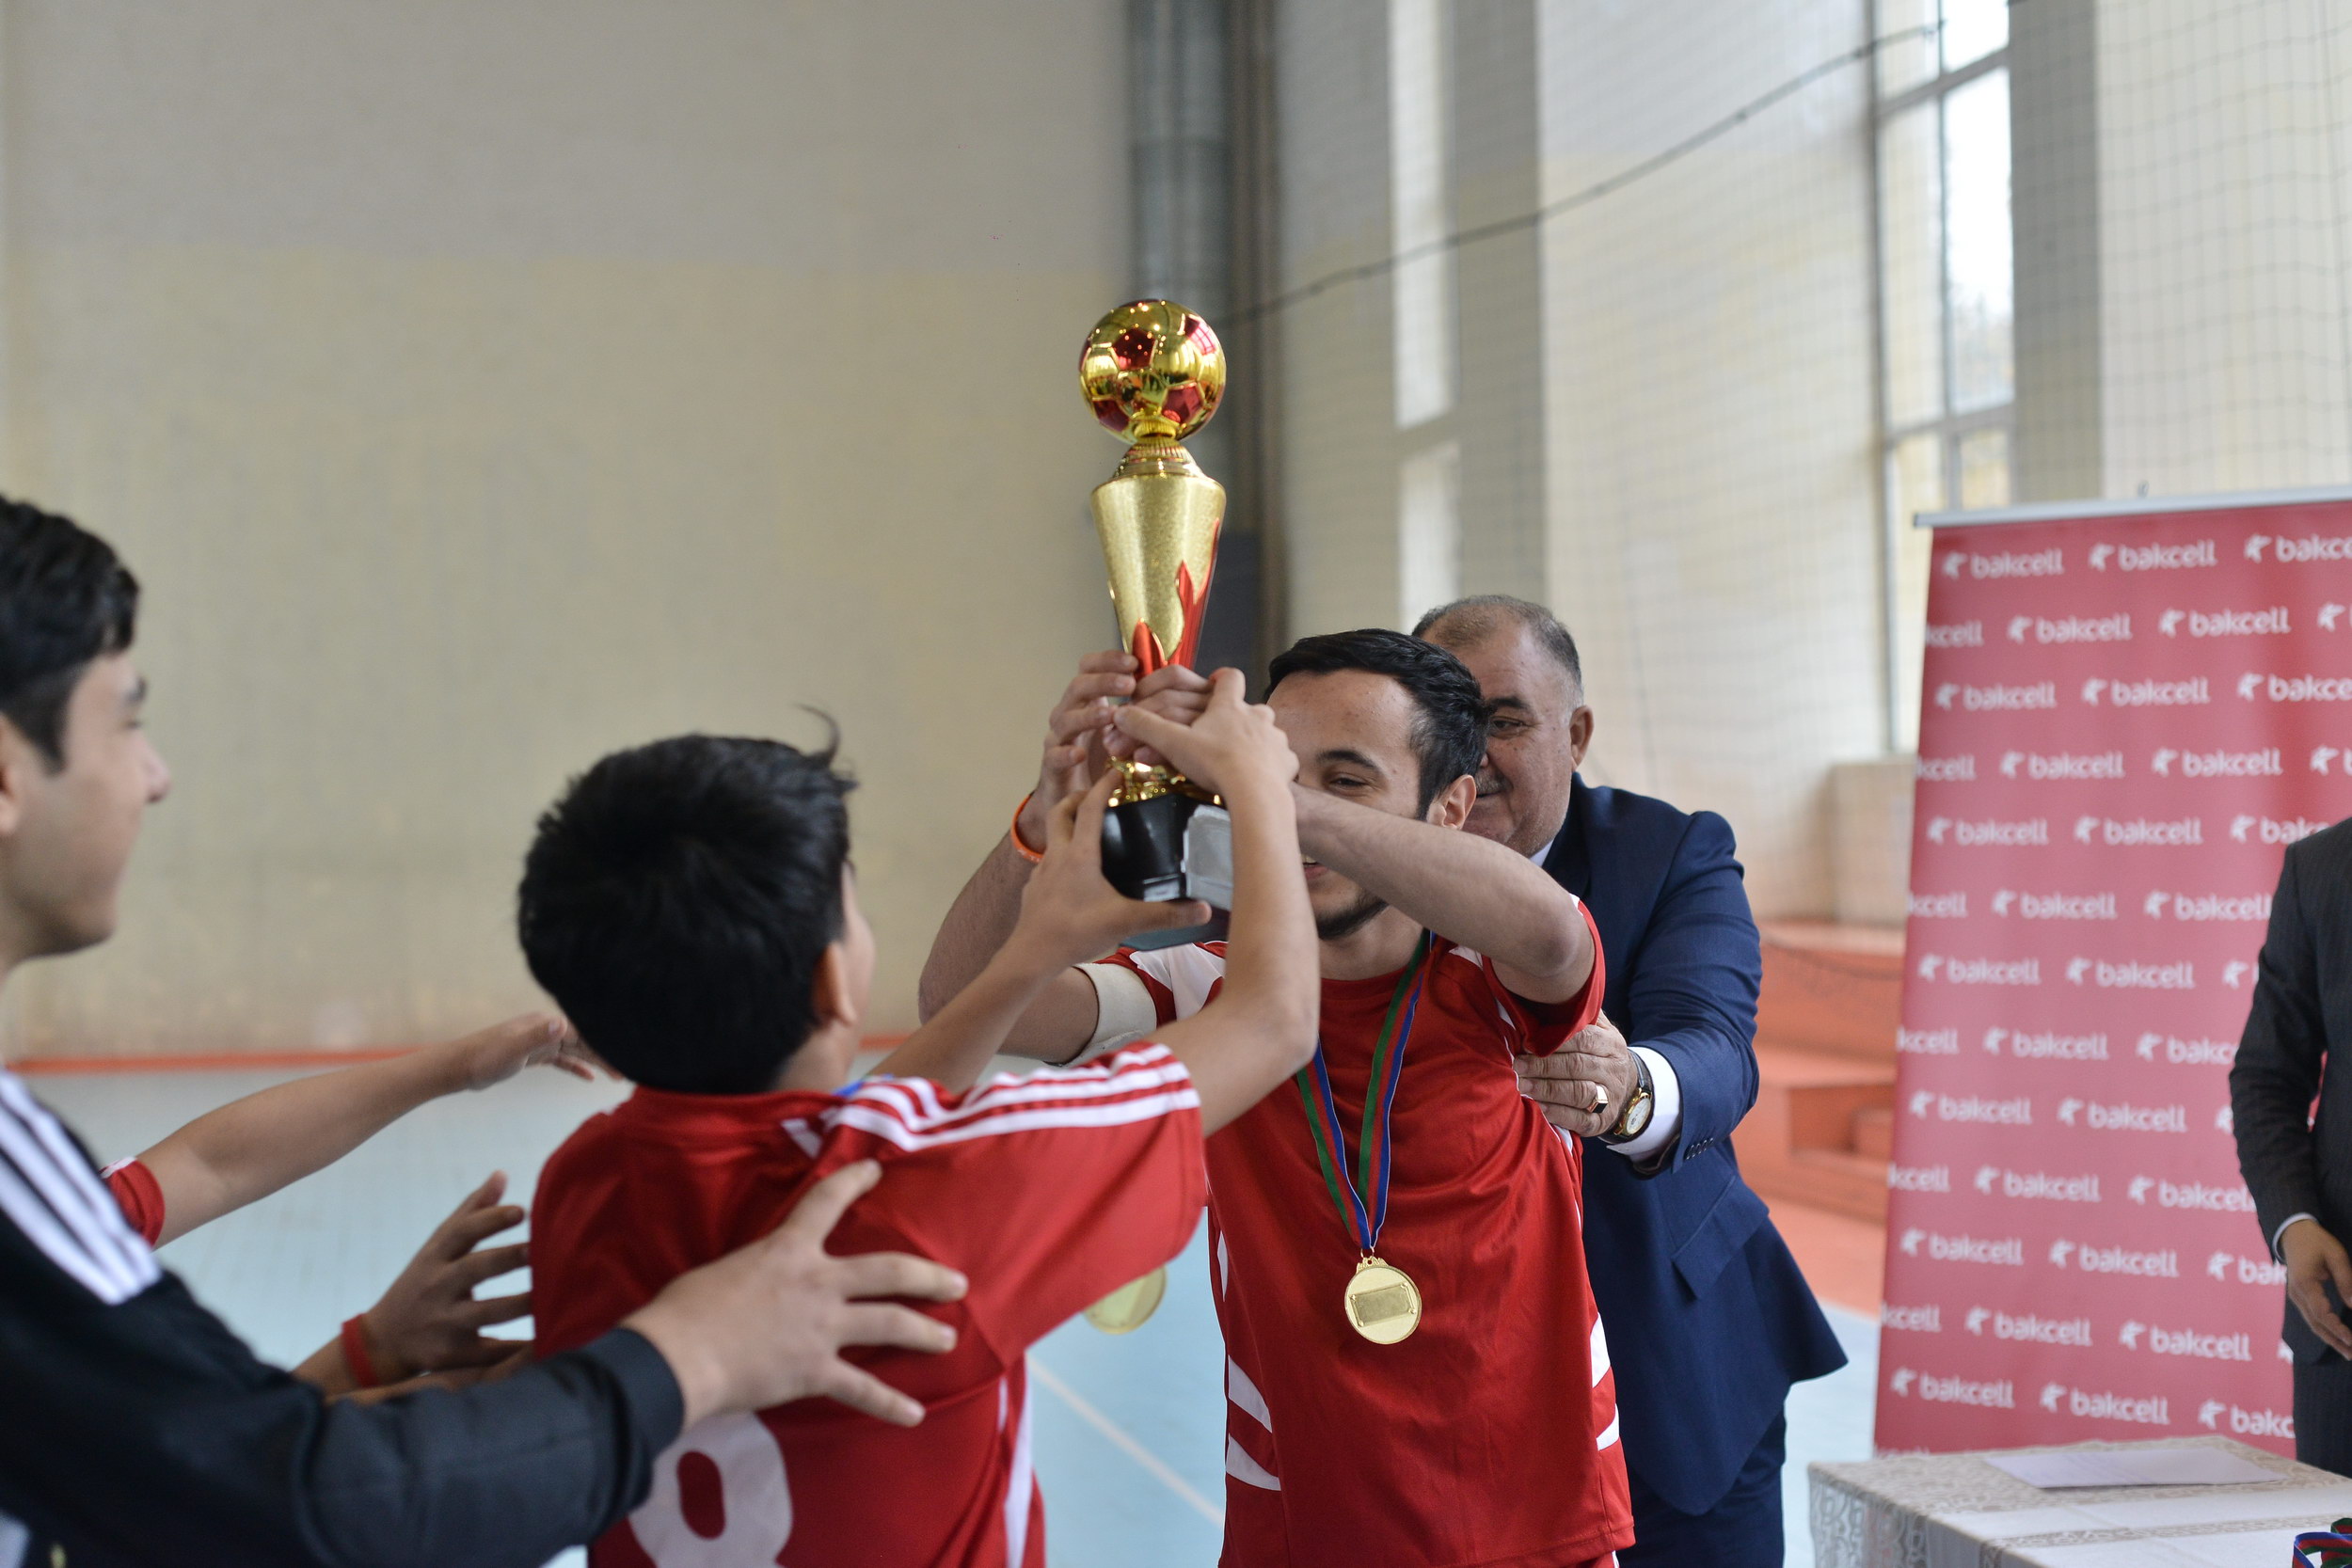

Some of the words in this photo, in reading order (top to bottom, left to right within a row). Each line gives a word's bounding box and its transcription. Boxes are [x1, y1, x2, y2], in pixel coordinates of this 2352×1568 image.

[1971, 548, 2064, 578] bakcell
[2119, 539, 2217, 571] bakcell
[2036, 613, 2132, 643] bakcell
[2189, 607, 2292, 638] bakcell
[1963, 682, 2057, 710] bakcell
[2111, 677, 2211, 706] bakcell
[2028, 752, 2124, 779] bakcell
[2182, 748, 2283, 777] bakcell
[1956, 818, 2048, 846] bakcell
[2104, 817, 2202, 846] bakcell
[2021, 892, 2118, 919] bakcell
[1947, 958, 2040, 985] bakcell
[2096, 960, 2194, 989] bakcell
[2012, 1030, 2109, 1060] bakcell
[2167, 1036, 2239, 1065] bakc
[1938, 1095, 2032, 1125] bakcell
[2088, 1101, 2187, 1132] bakcell
[2004, 1169, 2102, 1202] bakcell
[1930, 1233, 2024, 1266] bakcell
[2079, 1243, 2180, 1278] bakcell
[1994, 1310, 2092, 1347] bakcell
[2150, 1325, 2252, 1362] bakcell
[1919, 1372, 2015, 1409] bakcell
[2069, 1387, 2170, 1425] bakcell
